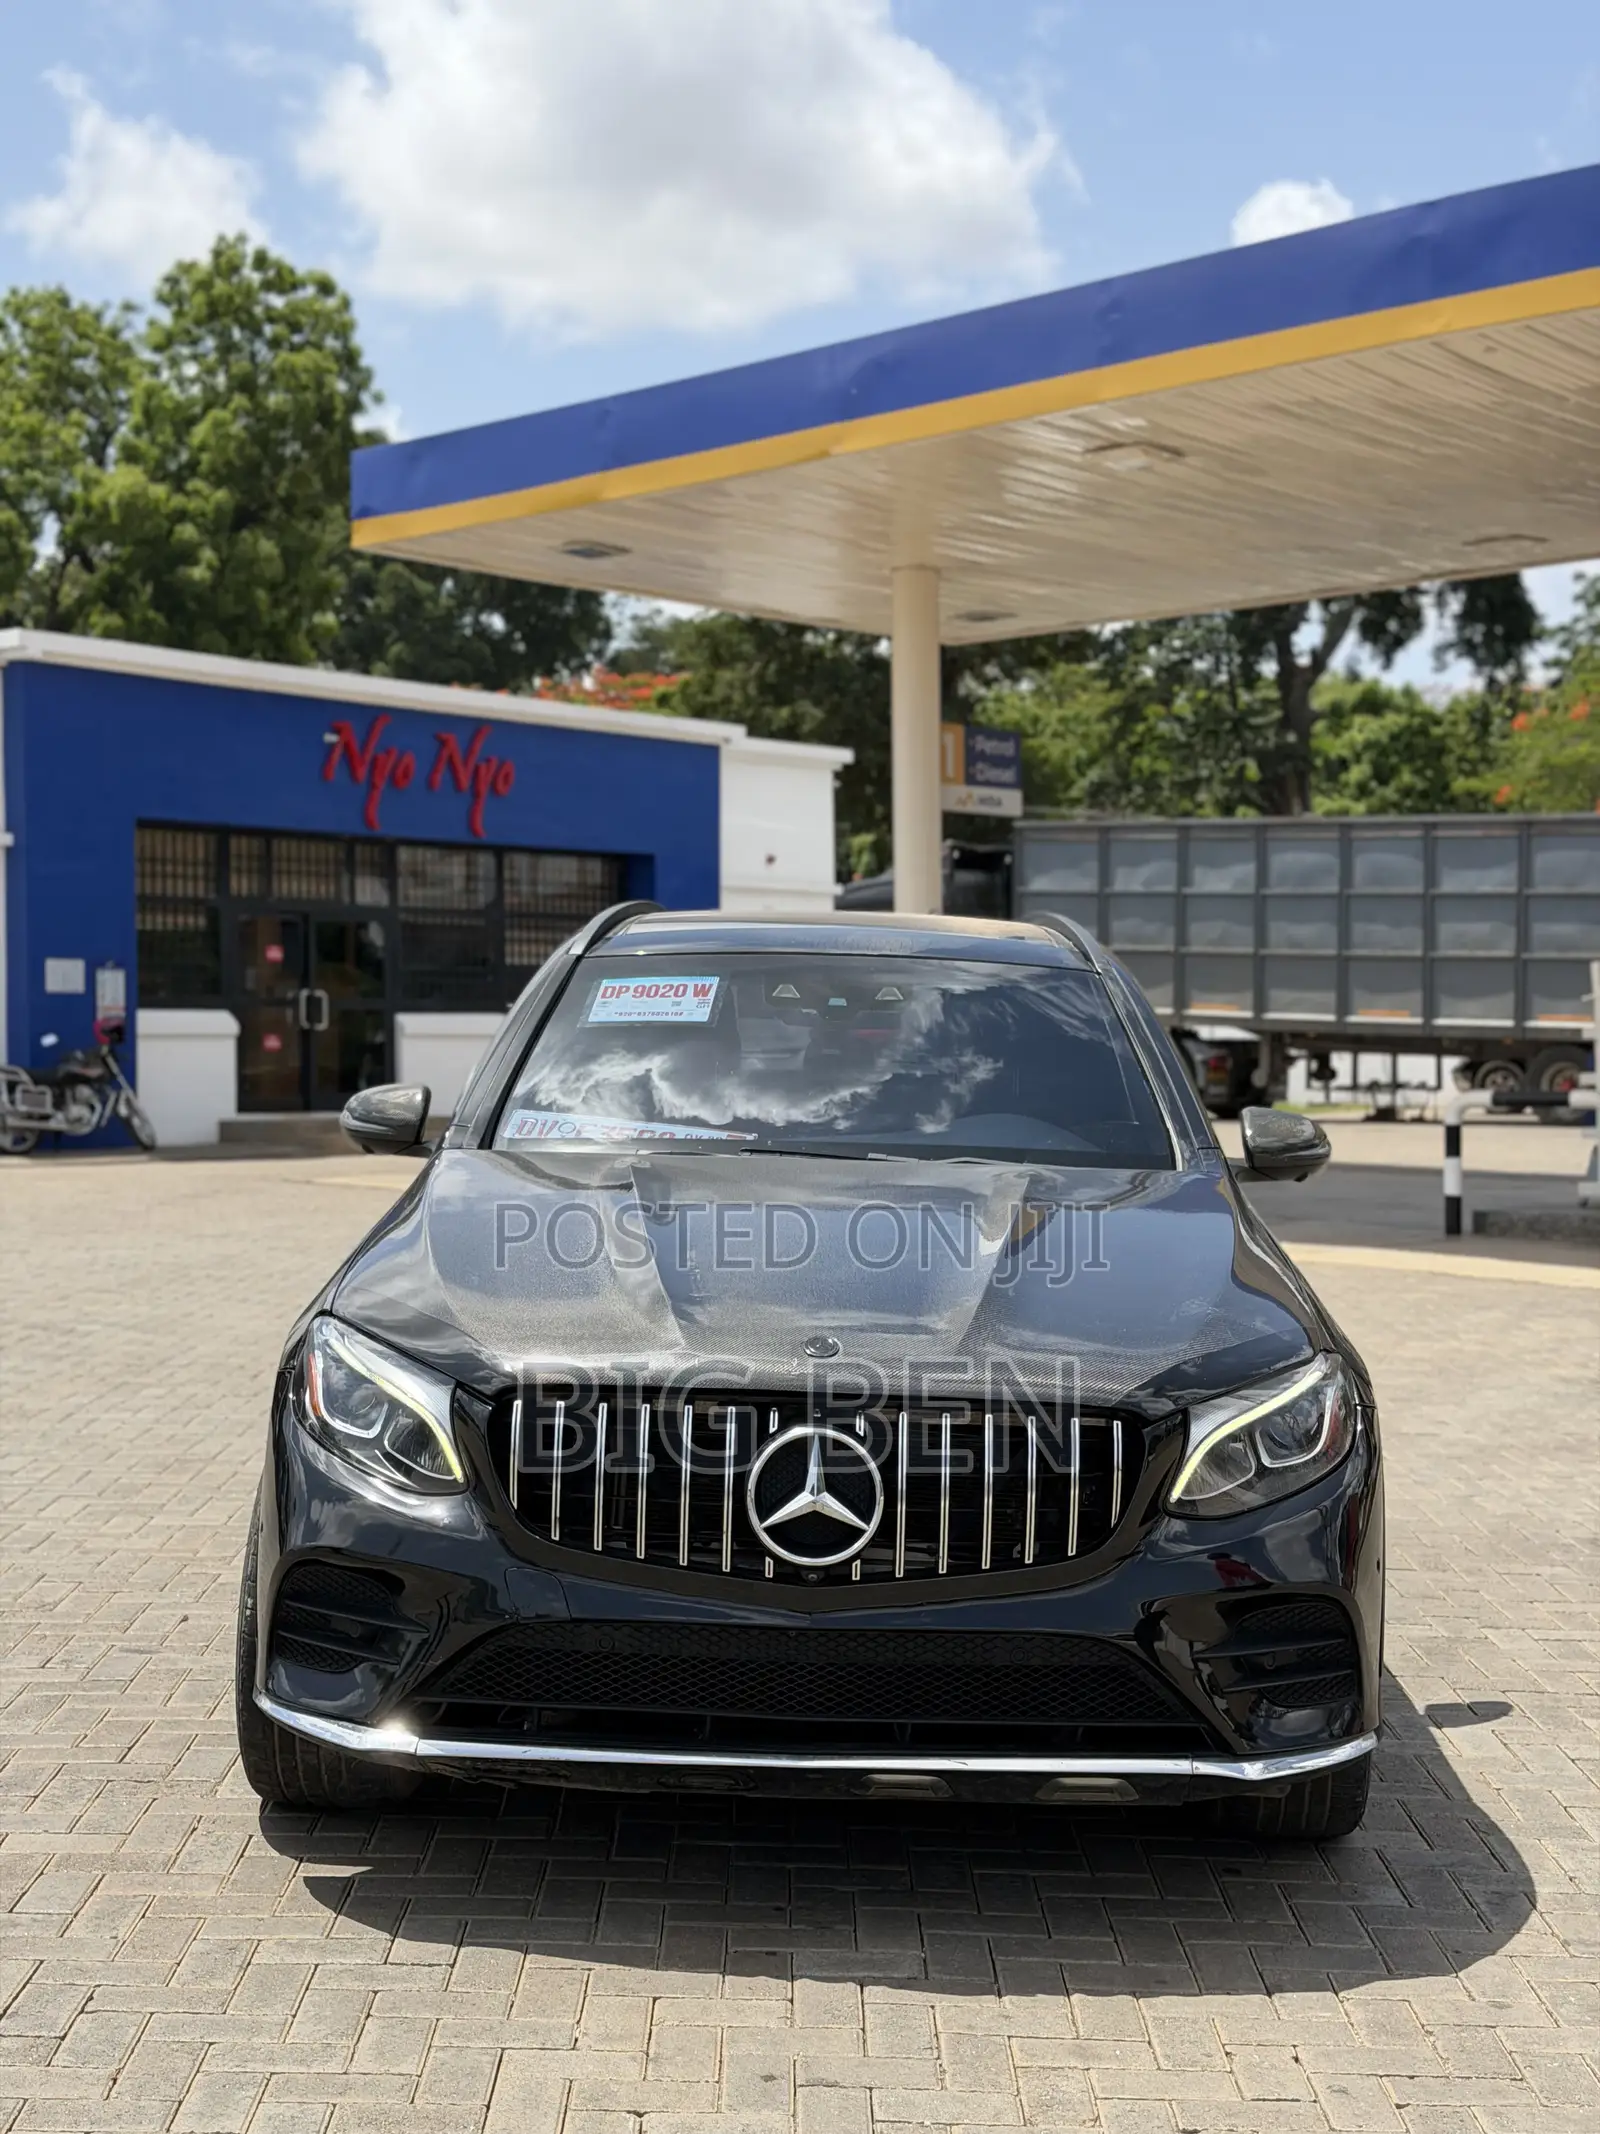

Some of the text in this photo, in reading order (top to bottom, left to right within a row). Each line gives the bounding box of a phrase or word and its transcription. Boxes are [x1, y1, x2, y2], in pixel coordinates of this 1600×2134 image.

[323, 713, 515, 839] Nyo Nyo
[600, 983, 714, 999] DP 9020 W
